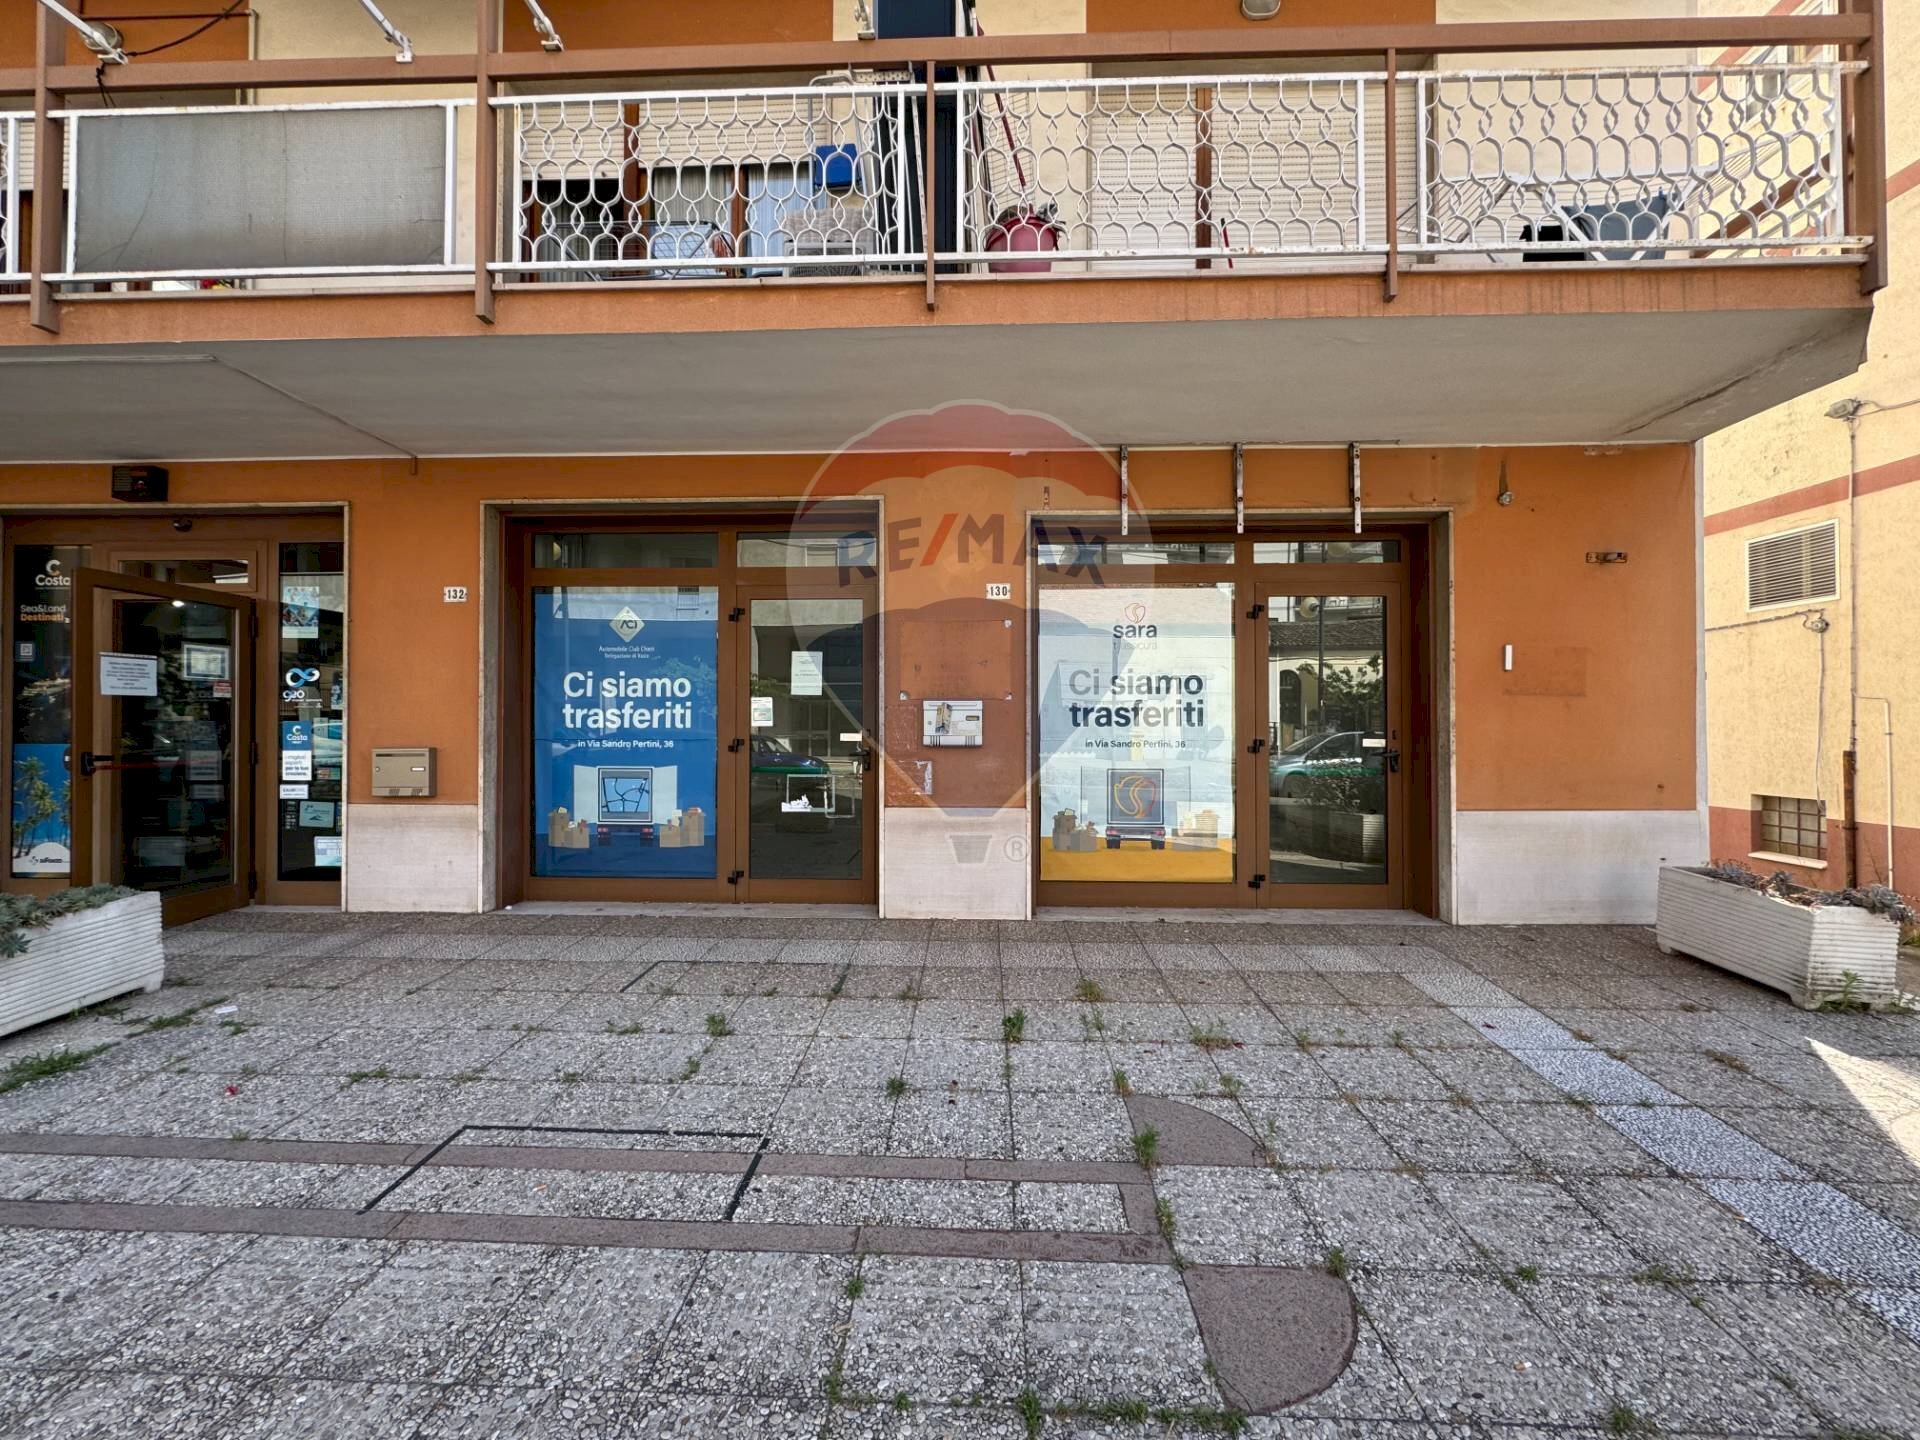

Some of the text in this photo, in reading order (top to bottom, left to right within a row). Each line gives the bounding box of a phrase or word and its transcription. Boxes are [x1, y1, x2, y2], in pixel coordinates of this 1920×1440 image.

[35, 574, 71, 586] Costa
[447, 589, 465, 600] 132
[989, 585, 1008, 597] 130
[620, 619, 638, 629] ACI
[1113, 624, 1157, 639] sara
[563, 671, 692, 698] Ci siamo
[1069, 668, 1204, 695] Ci siamo
[562, 701, 692, 729] trasferiti
[1068, 699, 1204, 727] trasferiti
[286, 733, 309, 741] Costa
[577, 739, 586, 748] in
[587, 739, 600, 748] Via
[602, 739, 631, 748] Sandro
[633, 739, 662, 750] Pertini,
[1085, 739, 1094, 748] in
[1095, 739, 1109, 748] Via
[1110, 739, 1142, 748] Sandro
[1143, 739, 1173, 750] Pertini,
